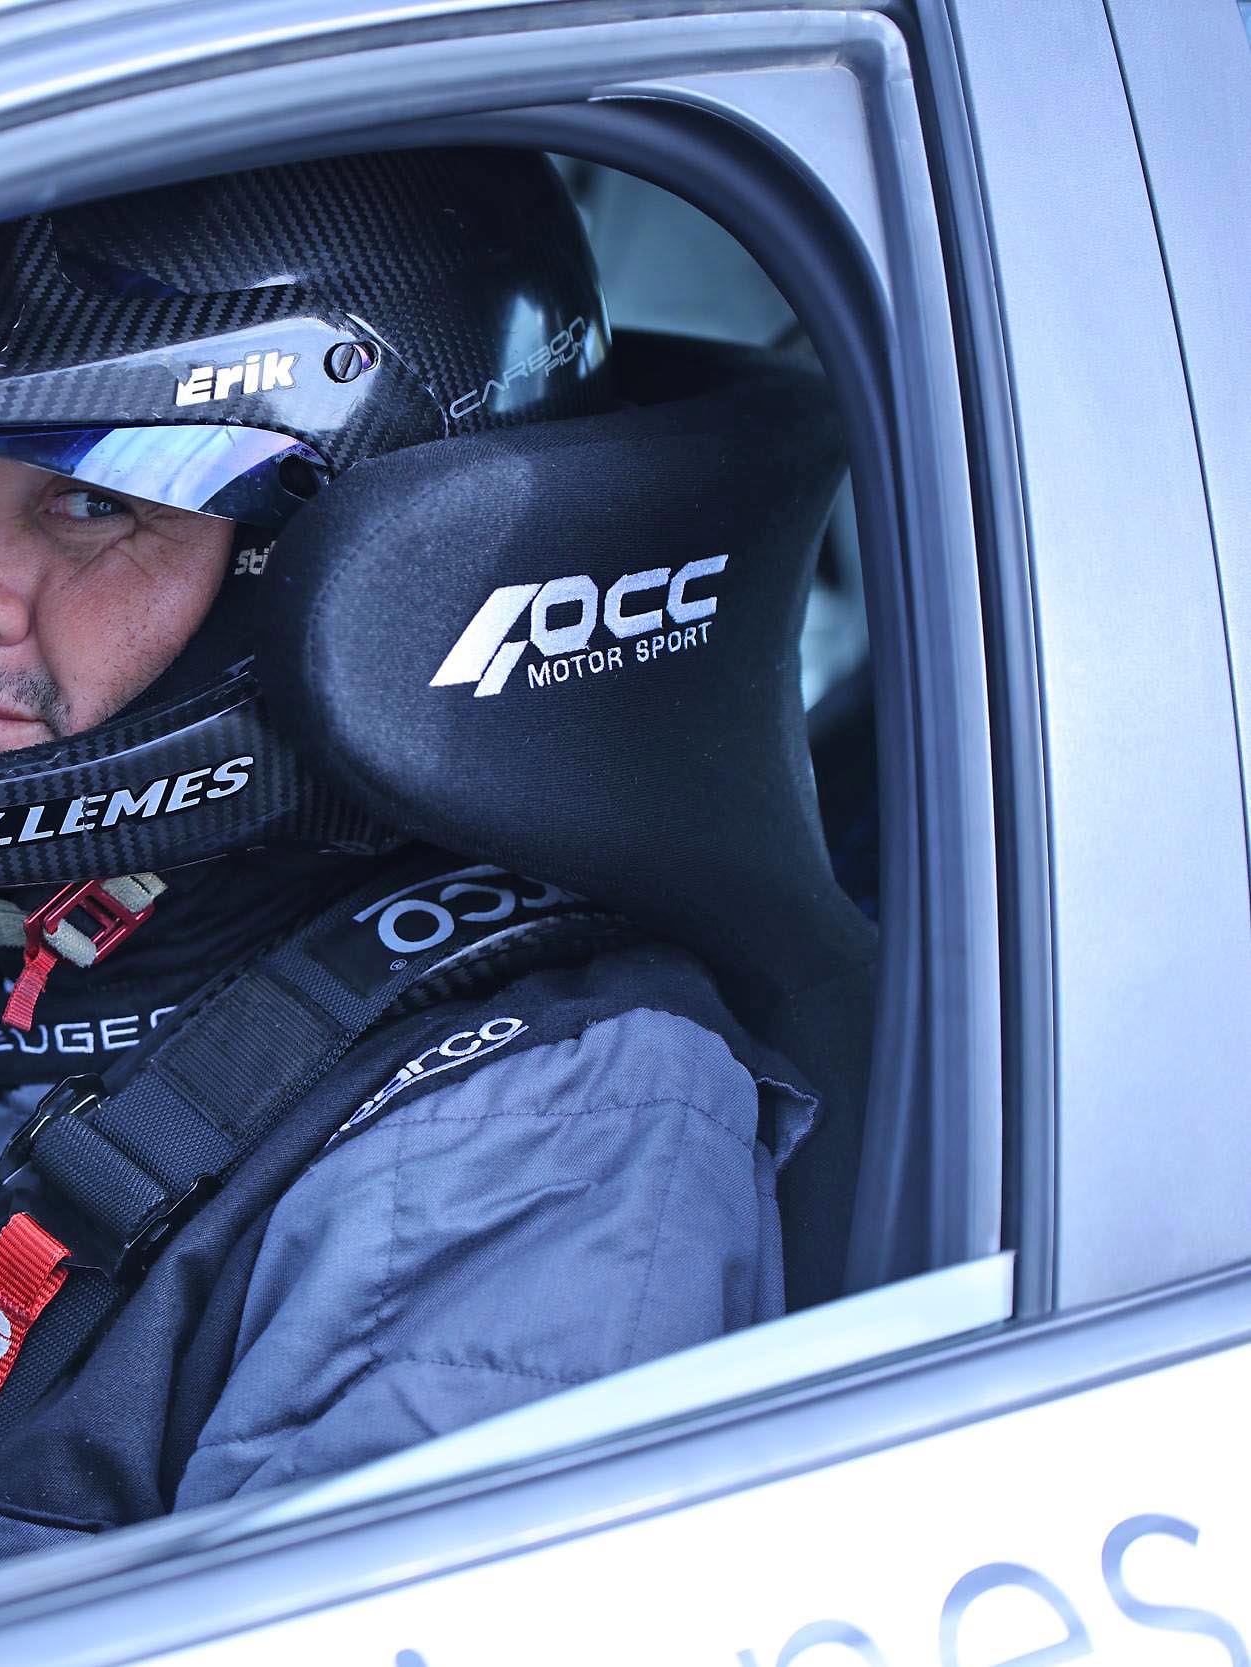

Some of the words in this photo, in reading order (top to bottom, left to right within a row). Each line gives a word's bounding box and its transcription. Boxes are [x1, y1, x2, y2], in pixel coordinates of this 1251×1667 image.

[175, 350, 296, 407] Erik
[450, 316, 586, 419] CARBON
[530, 554, 729, 657] OCC
[527, 647, 624, 689] MOTOR
[635, 622, 713, 663] SPORT
